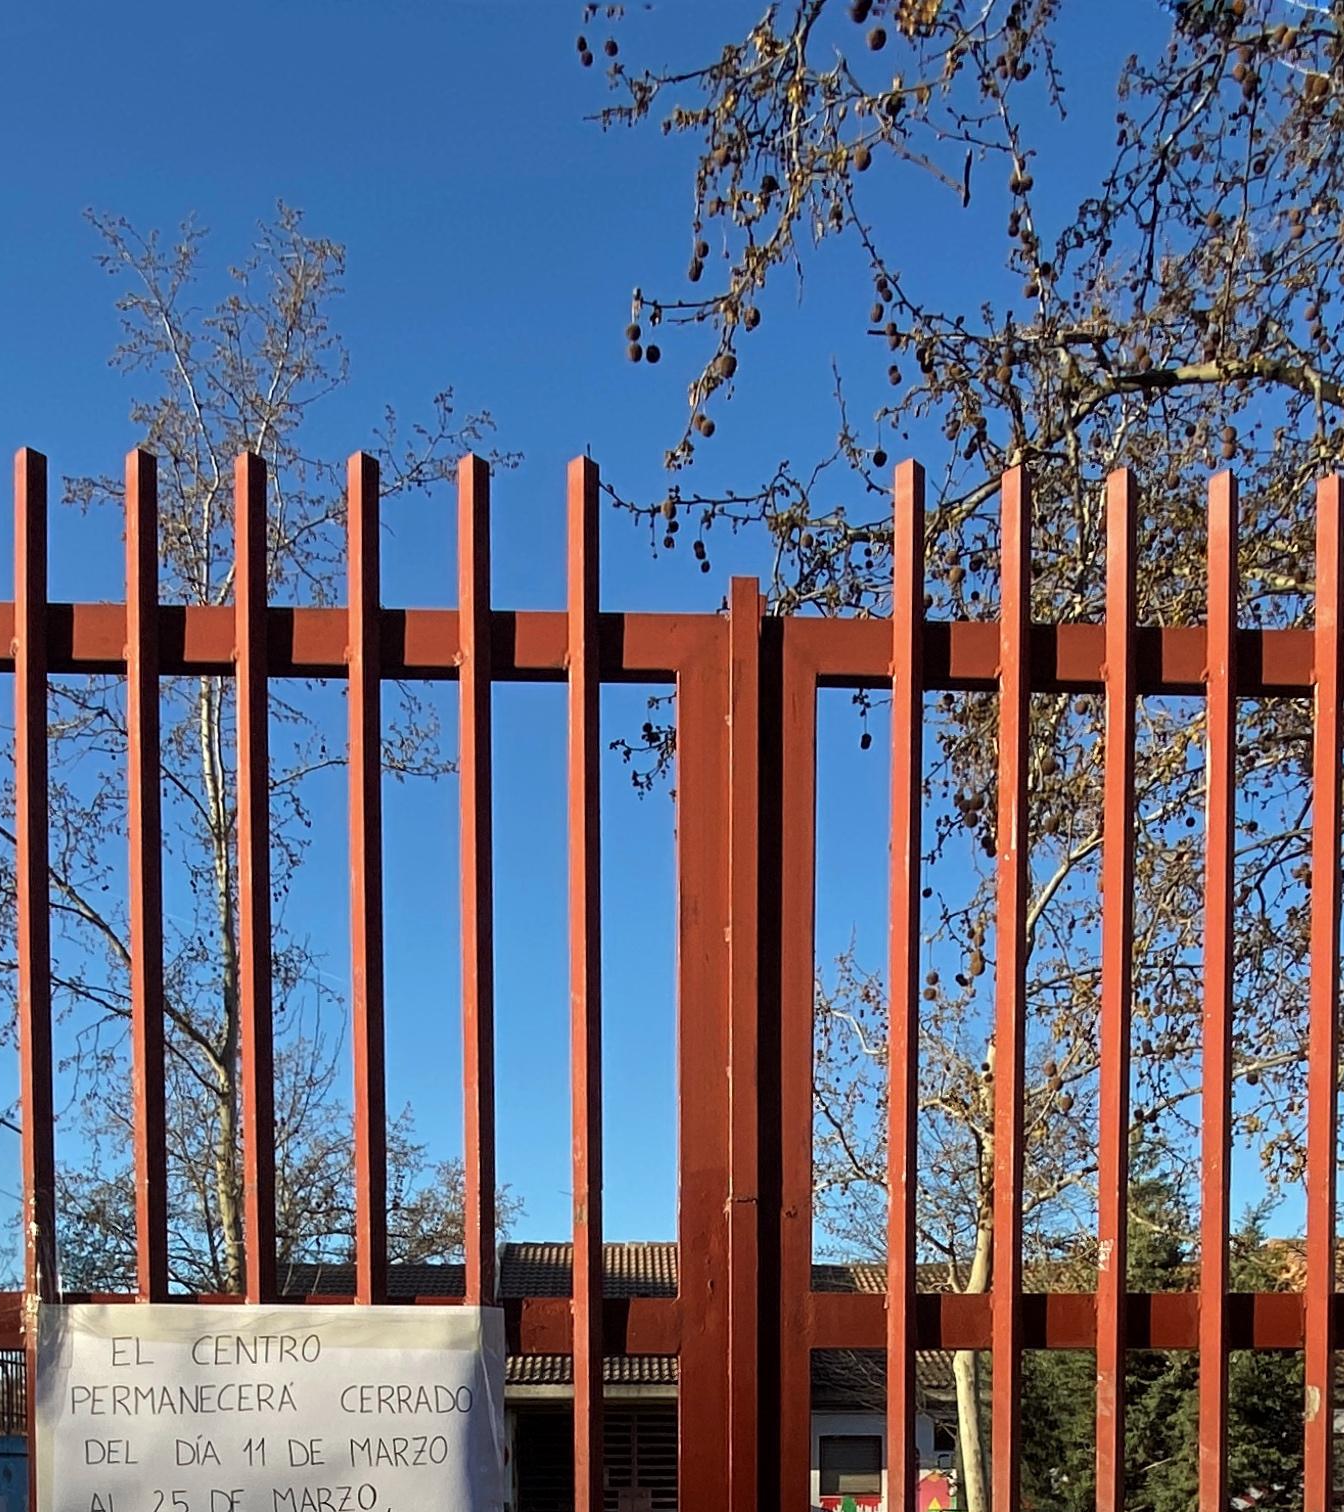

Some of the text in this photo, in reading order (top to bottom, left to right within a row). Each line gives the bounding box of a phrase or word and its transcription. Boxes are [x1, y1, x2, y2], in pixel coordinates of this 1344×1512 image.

[111, 1333, 321, 1367] EL CENTRO
[71, 1381, 473, 1416] PERMANECERÁ CERRADO
[84, 1433, 448, 1468] DEL DÍA 11 DE MARZO
